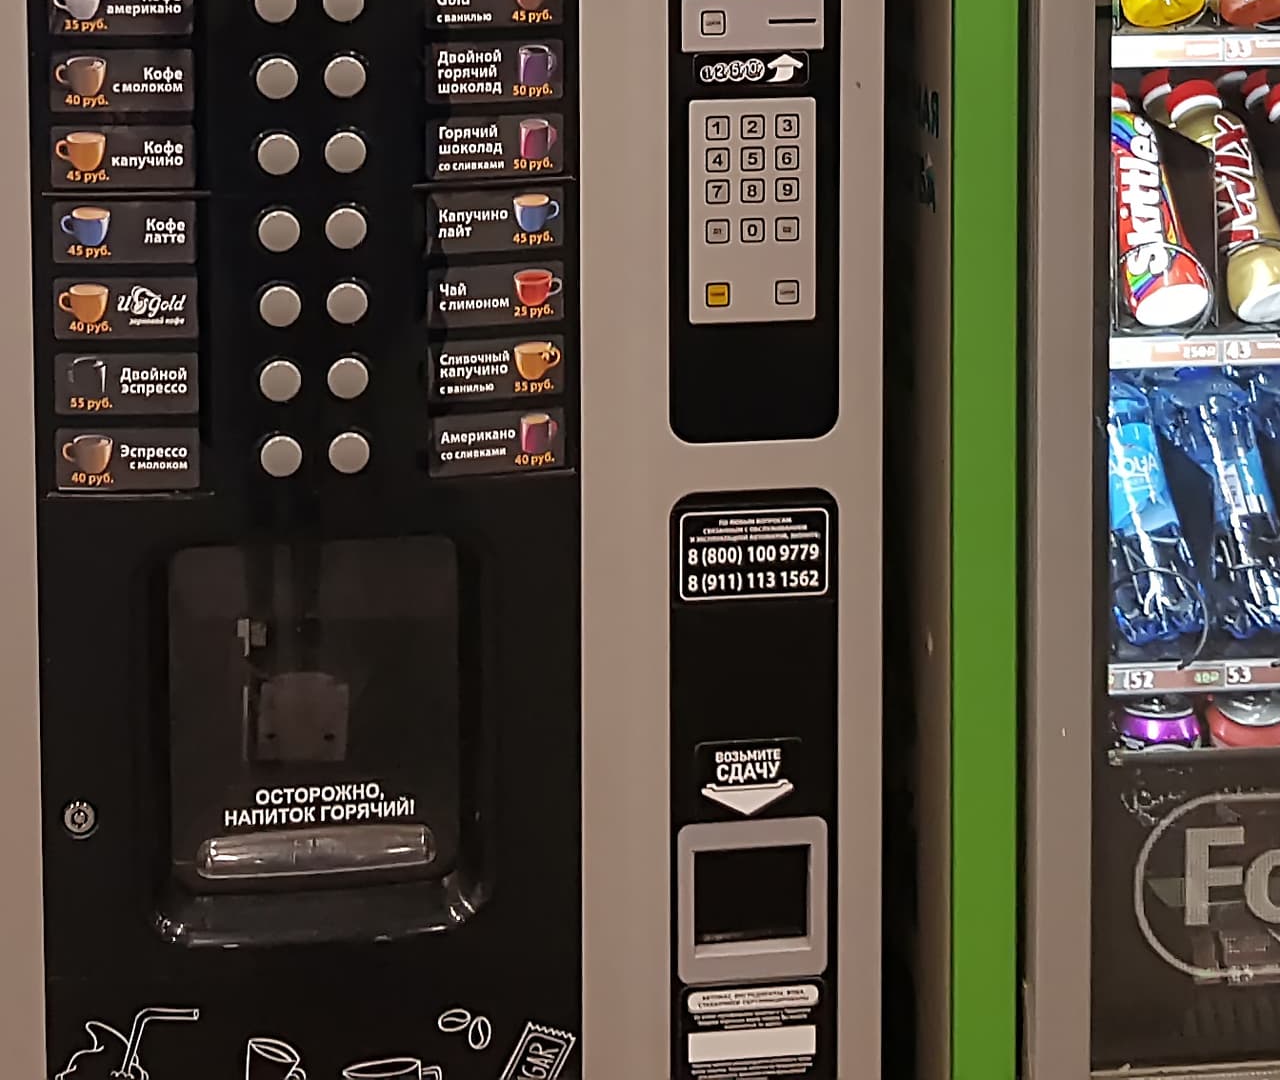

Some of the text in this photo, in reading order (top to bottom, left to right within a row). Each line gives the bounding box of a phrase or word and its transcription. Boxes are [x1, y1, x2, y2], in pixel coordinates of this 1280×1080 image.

[106, 3, 182, 17] американо
[64, 20, 79, 31] 35
[437, 50, 502, 67] Двойной
[143, 66, 183, 84] Кофе
[437, 64, 498, 81] горячий
[122, 82, 183, 94] молоком
[437, 81, 503, 96] шоколад
[513, 84, 527, 96] 50
[65, 94, 80, 106] 40
[439, 125, 499, 142] Горячий
[143, 140, 184, 158] Кофе
[439, 140, 503, 156] шоколад
[111, 155, 184, 171] капучино
[146, 217, 185, 234] Кофе
[439, 209, 509, 226] Капучино
[144, 232, 186, 245] латте
[438, 224, 472, 239] лайт
[513, 233, 528, 244] 45
[439, 282, 467, 297] Чай
[447, 297, 510, 312] лимоном
[439, 351, 510, 367] Сливочный
[120, 367, 187, 384] Двойной
[439, 364, 509, 381] капучино
[120, 383, 188, 398] эспрессо
[440, 427, 517, 445] Американо
[120, 445, 188, 463] Эспрессо
[687, 543, 820, 567] 8 (800) 100 9779
[687, 569, 820, 593] 8 (911) 113 1562
[1227, 665, 1252, 683] 53
[715, 748, 781, 764] ВОЗЬМИТЕ
[716, 762, 780, 784] СДАЧУ
[255, 782, 385, 807] ОСТОРОЖНО,
[224, 798, 416, 827] НАПИТОК ГОРЯЧИЙ!
